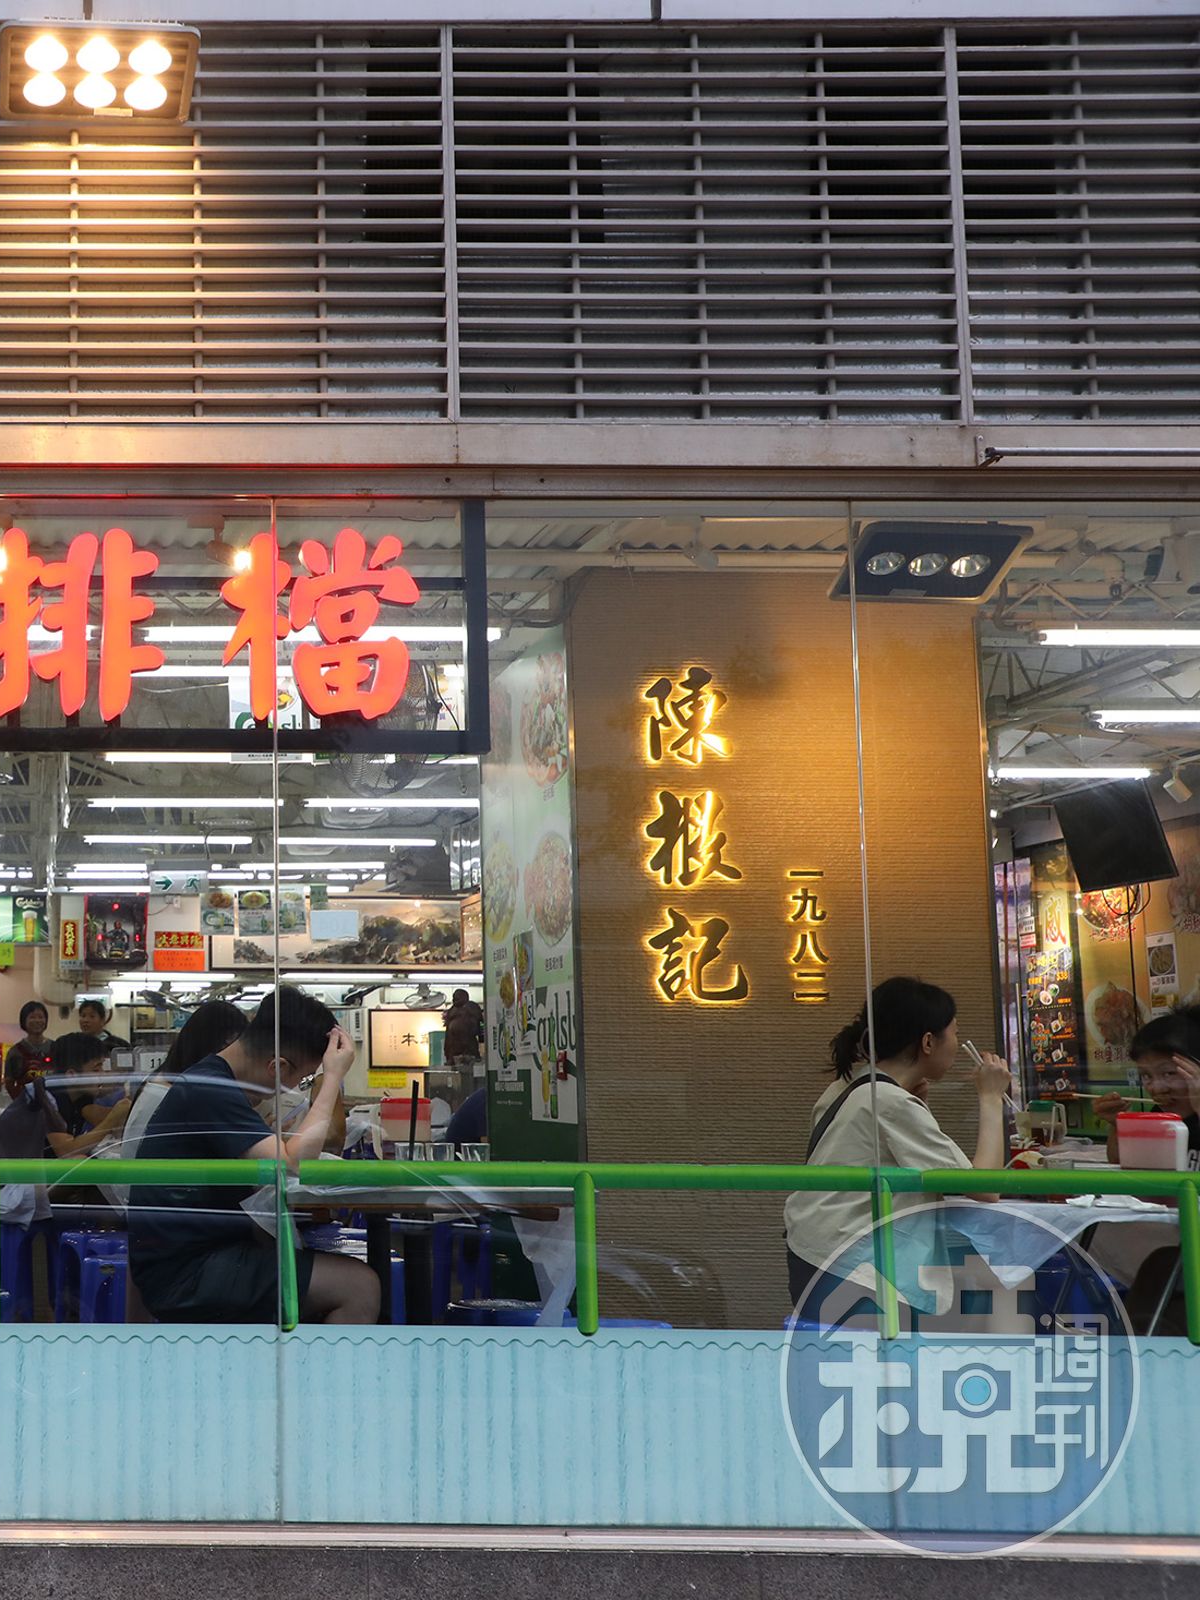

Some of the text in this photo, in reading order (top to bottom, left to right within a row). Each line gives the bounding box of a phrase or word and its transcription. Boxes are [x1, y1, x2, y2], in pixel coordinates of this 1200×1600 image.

[644, 665, 749, 1003] 陳根記
[788, 869, 830, 1001] 一九八二
